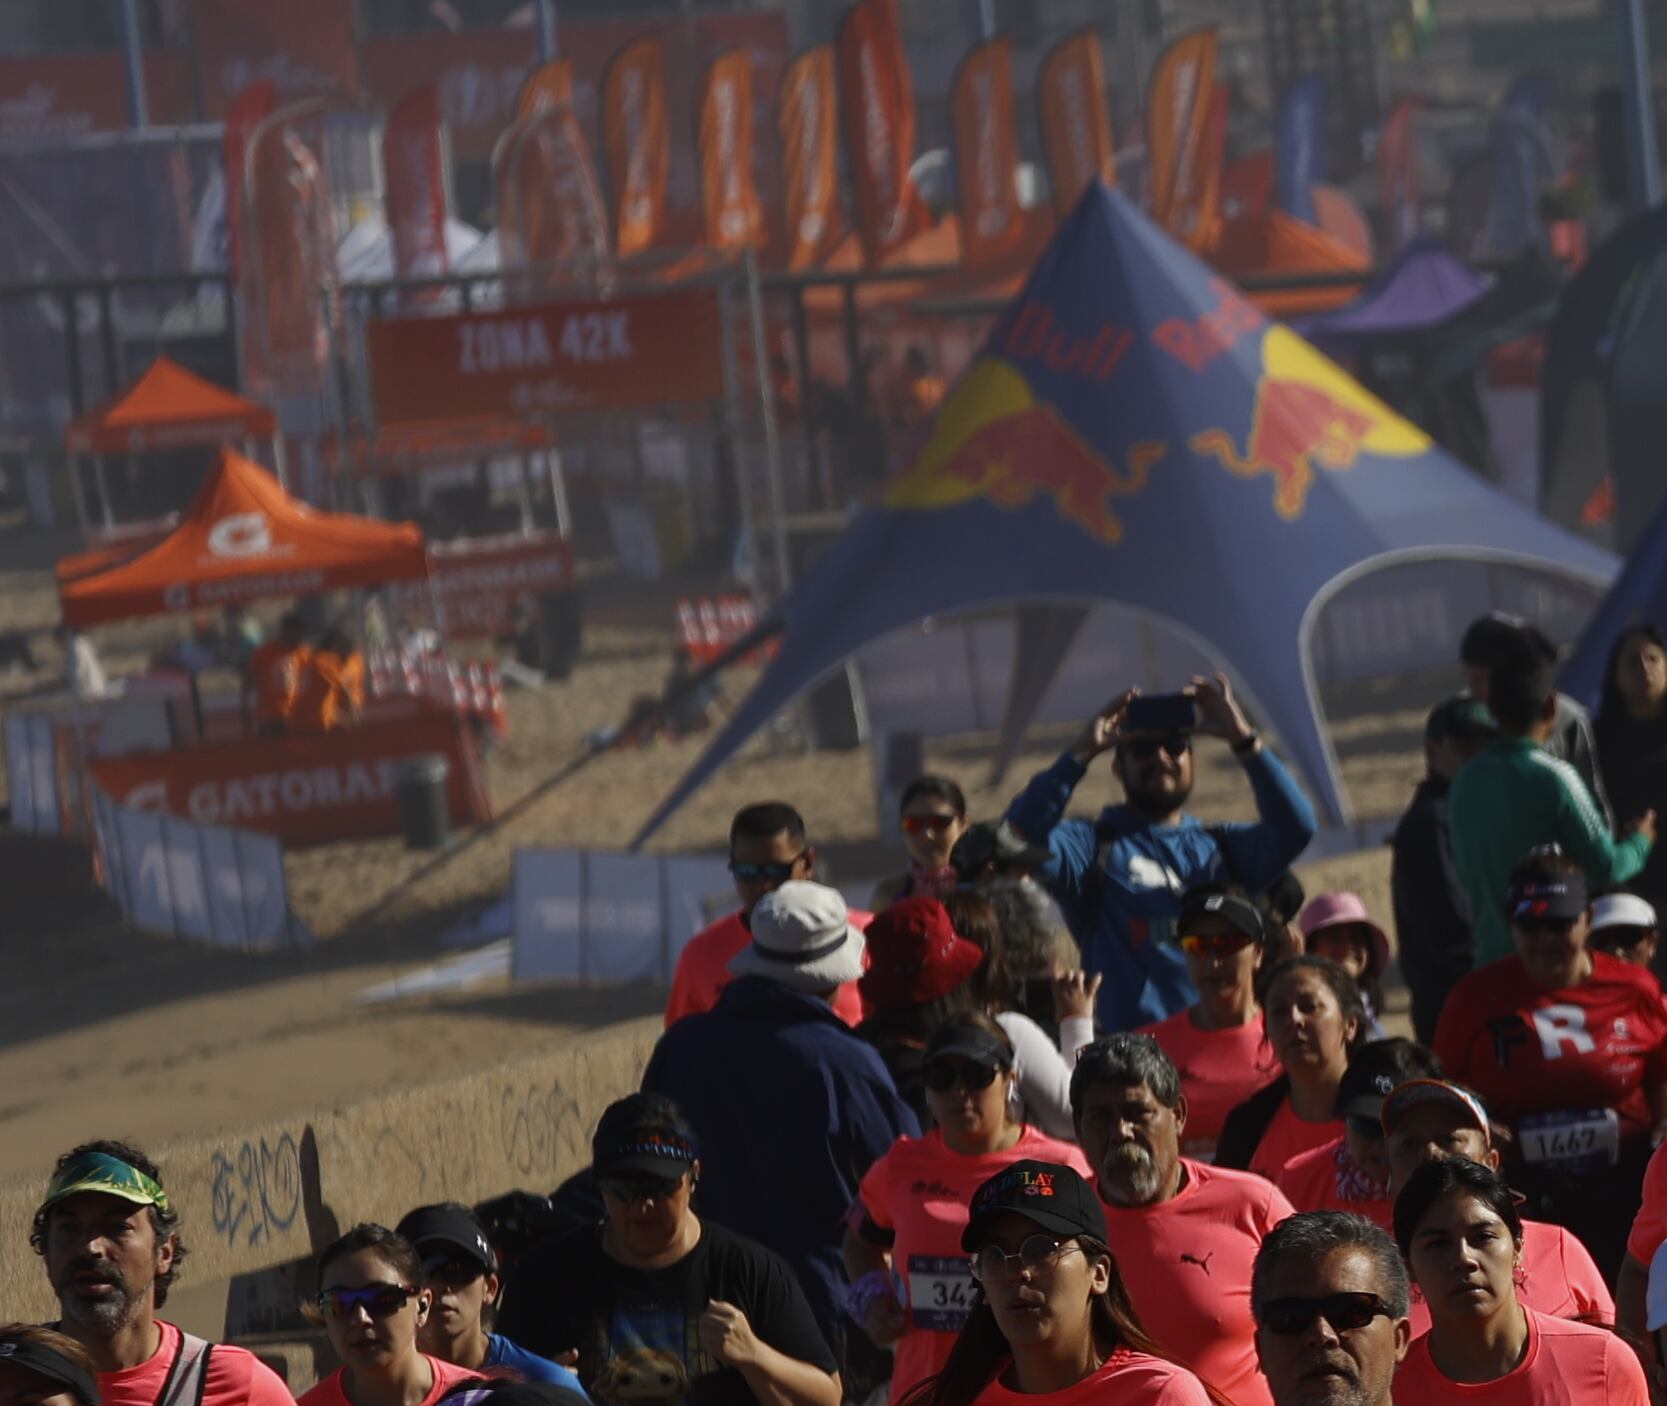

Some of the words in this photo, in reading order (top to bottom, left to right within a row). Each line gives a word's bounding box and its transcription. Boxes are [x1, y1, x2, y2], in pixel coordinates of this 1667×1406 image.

[459, 318, 552, 373] ZONA
[559, 311, 633, 364] 42K
[1005, 299, 1136, 383] Bull
